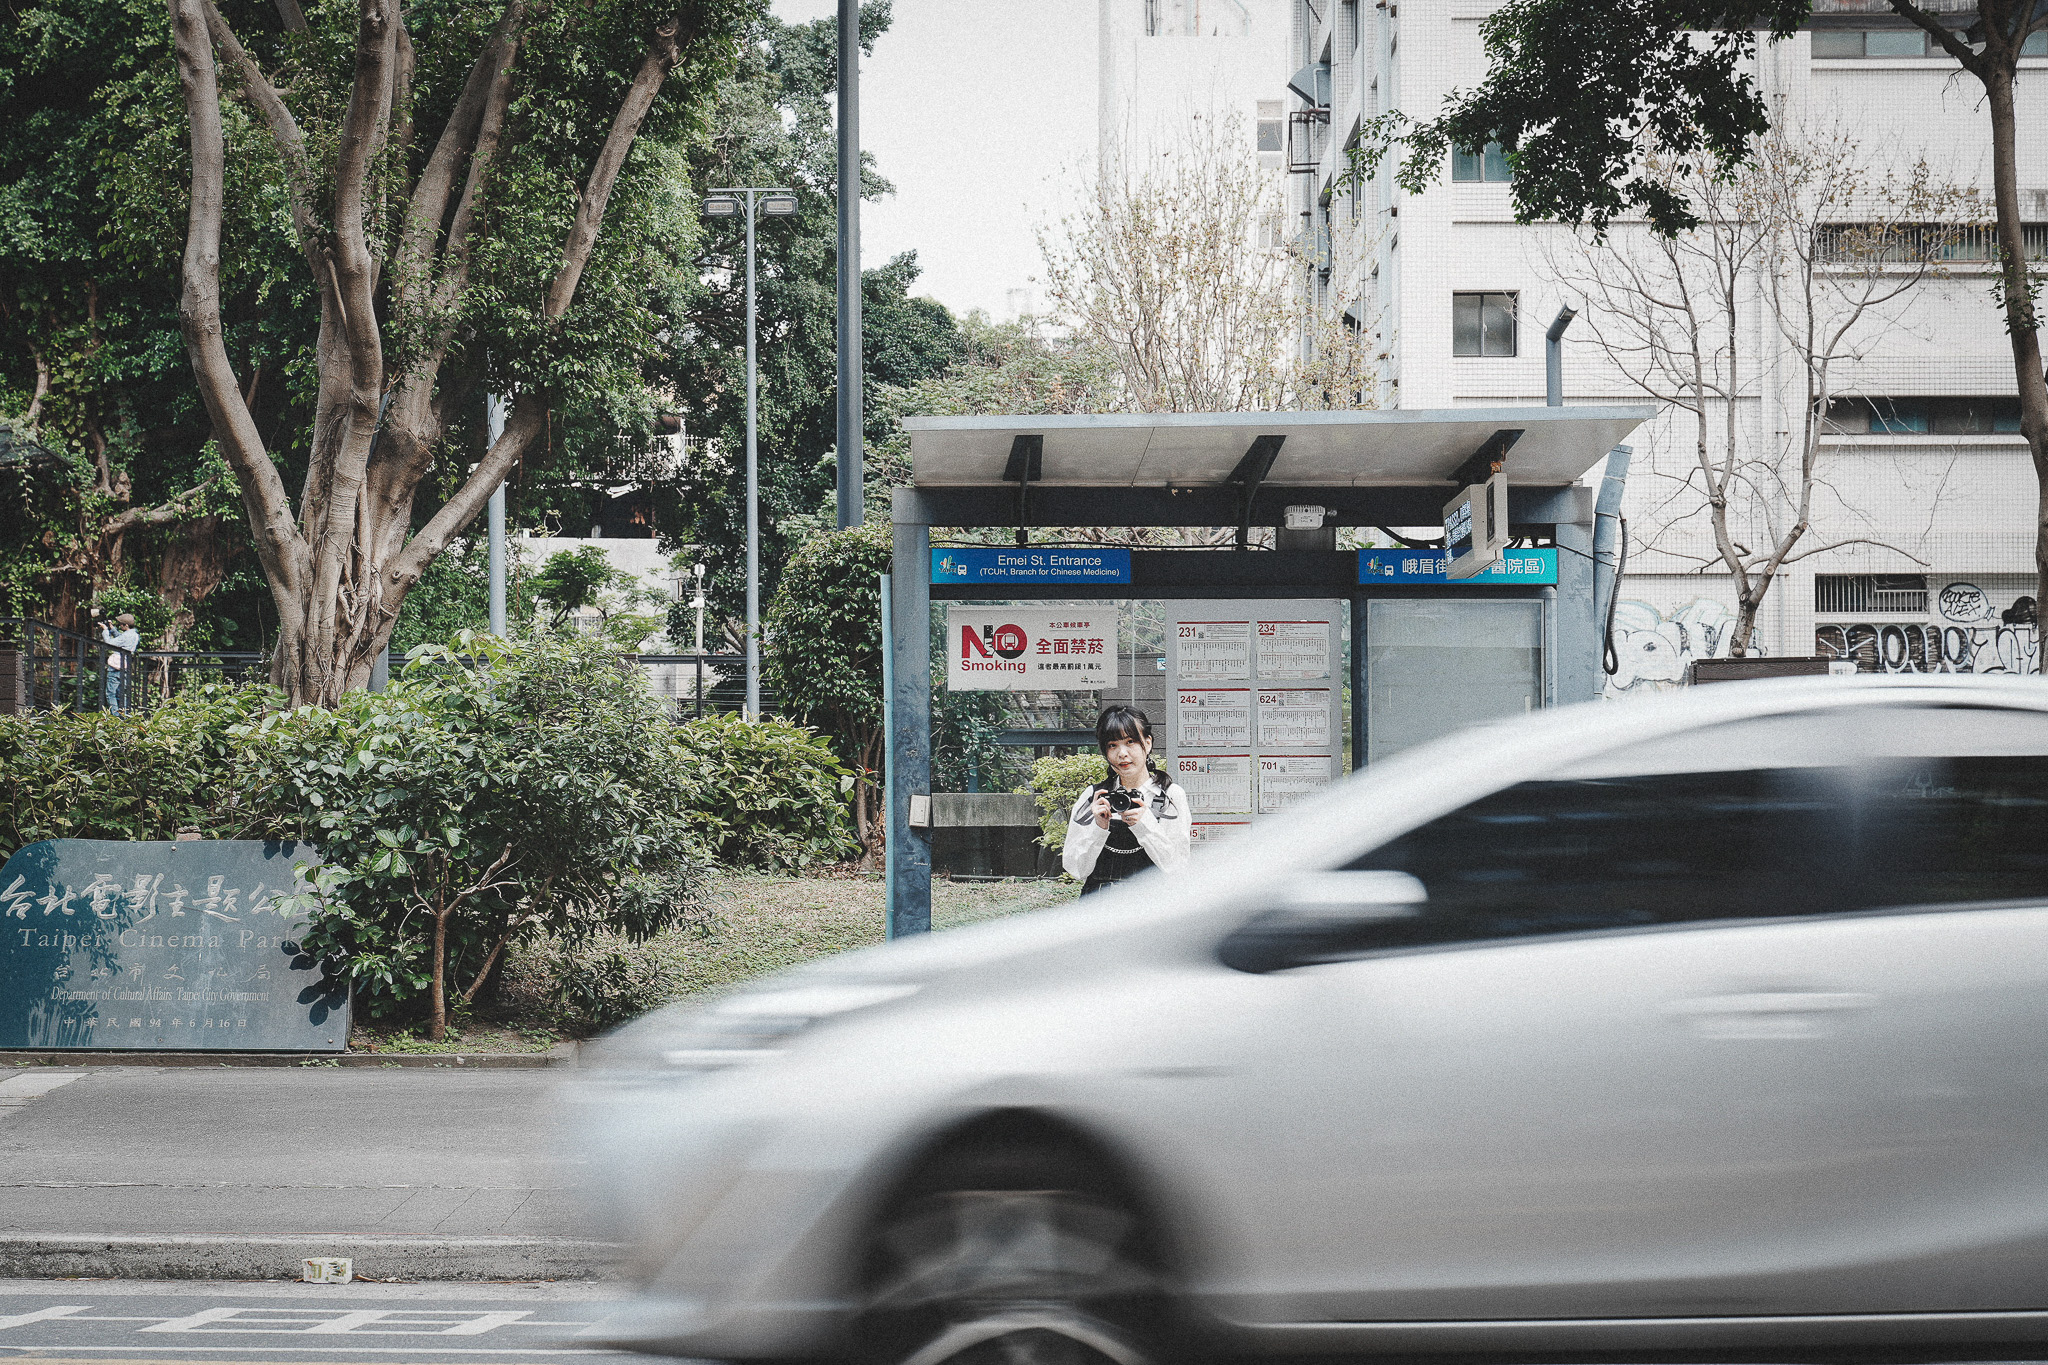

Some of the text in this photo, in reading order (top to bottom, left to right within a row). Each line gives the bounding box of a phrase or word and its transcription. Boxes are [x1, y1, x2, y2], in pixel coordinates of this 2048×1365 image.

[998, 555, 1102, 566] Emei St. Entrance
[1010, 568, 1037, 576] Branch
[1038, 568, 1049, 576] for
[1050, 568, 1082, 576] Chinese
[1083, 568, 1120, 577] Medicine)
[1178, 627, 1197, 638] 231
[1258, 624, 1276, 633] 234
[961, 623, 1028, 660] NO
[1036, 638, 1104, 655] 全面禁菸
[961, 660, 1026, 674] Smoking
[1180, 695, 1197, 704] 242
[1259, 695, 1277, 704] 624
[1179, 761, 1198, 772] 658
[1261, 761, 1278, 770] 701
[18, 928, 300, 953] Taipei Cinema Park
[51, 985, 270, 1006] Department of Cultural Affairs Taipei City Government
[64, 1016, 247, 1029] 中華民國94年6月16日
